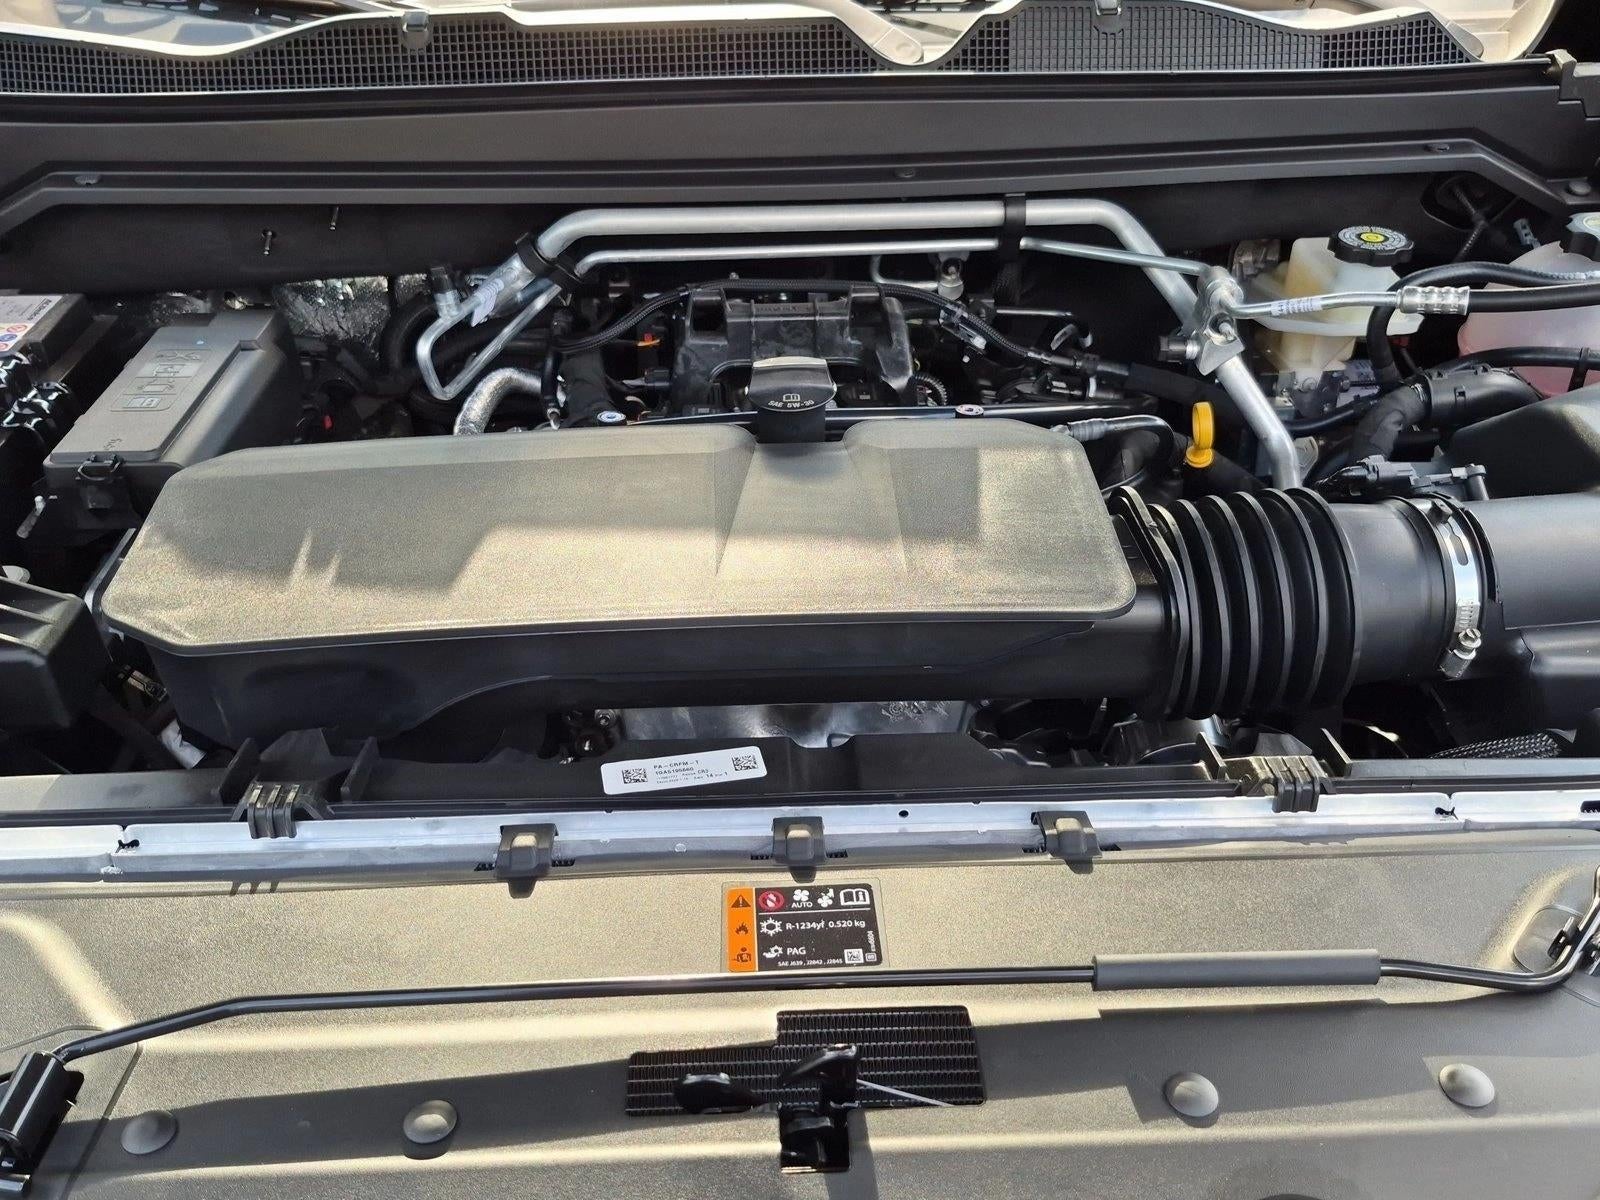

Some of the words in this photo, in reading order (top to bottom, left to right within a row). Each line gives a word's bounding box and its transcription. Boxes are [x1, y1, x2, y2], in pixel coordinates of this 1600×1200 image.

[768, 400, 784, 408] SAE
[787, 400, 815, 408] 5W-30
[786, 920, 825, 930] R-1234yf
[828, 920, 853, 928] 0.520
[854, 919, 866, 928] kg
[786, 946, 807, 955] PAG
